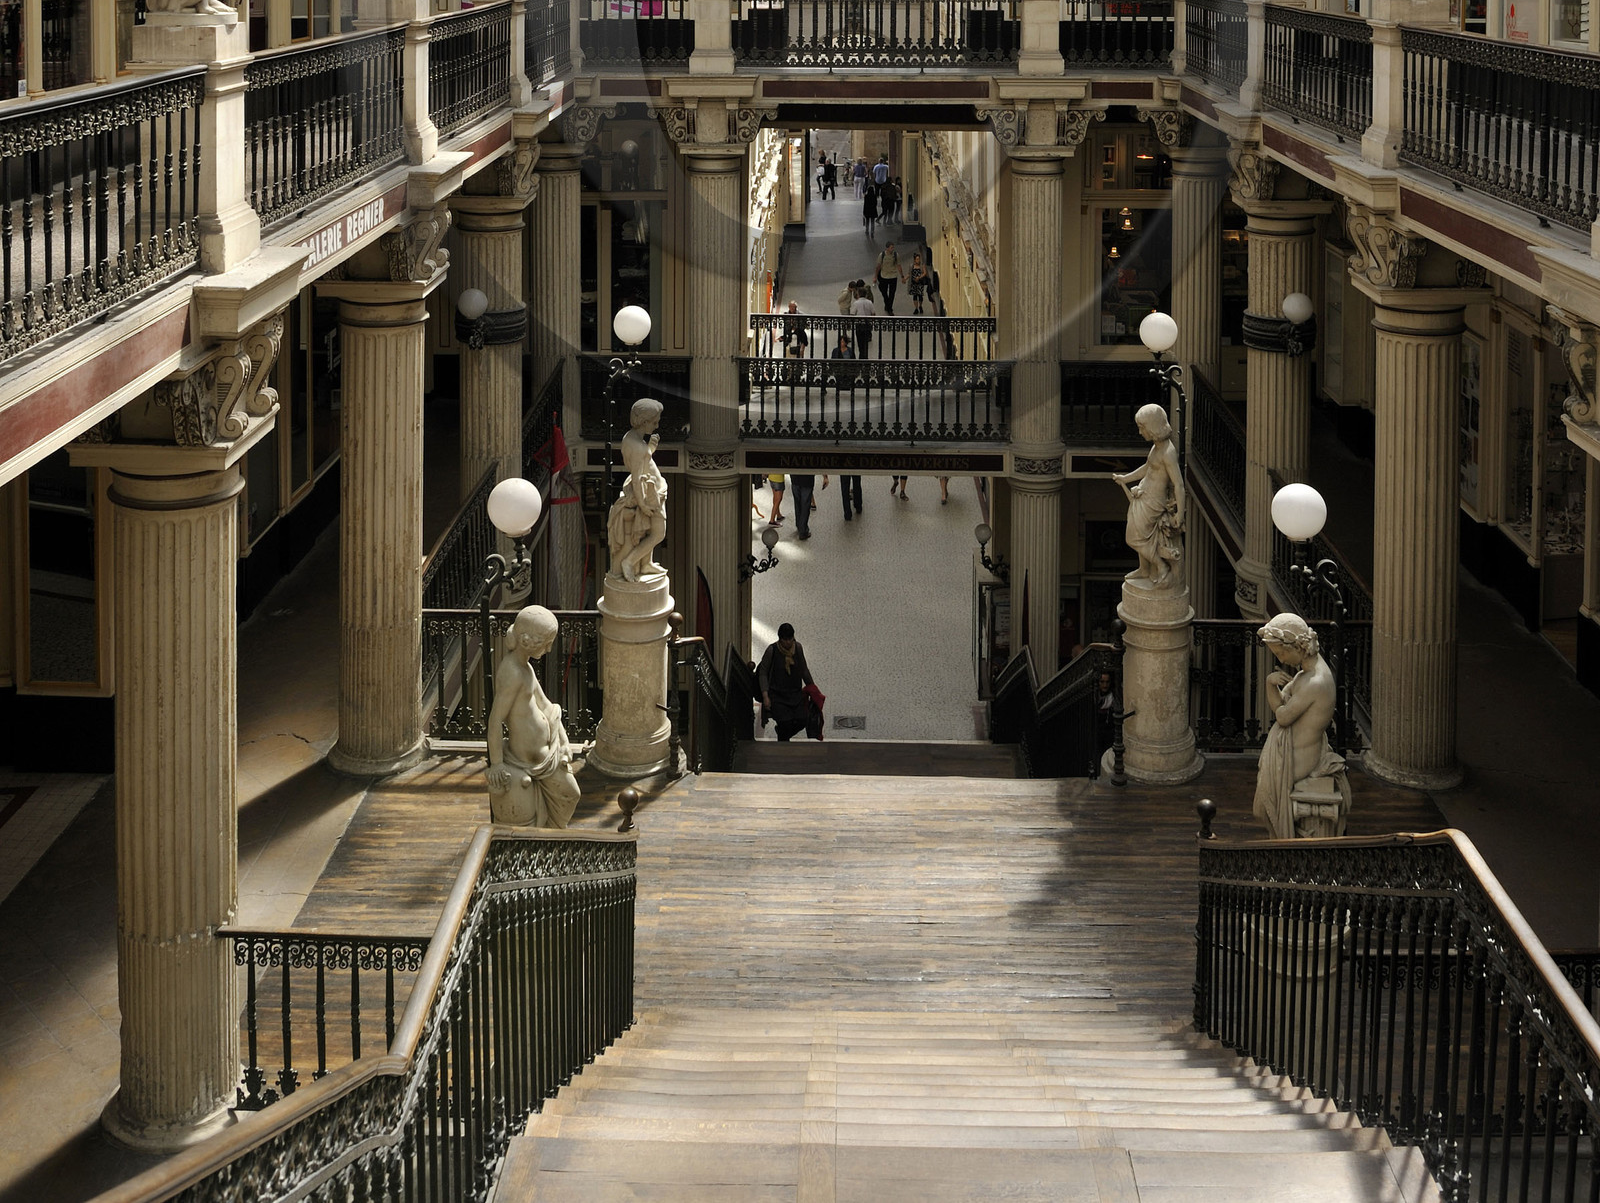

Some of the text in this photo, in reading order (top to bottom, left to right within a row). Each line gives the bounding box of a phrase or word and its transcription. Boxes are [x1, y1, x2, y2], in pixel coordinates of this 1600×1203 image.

[301, 197, 385, 271] GALERIE REGNIER
[780, 453, 970, 470] NATURE & DÉCOUVERTES
